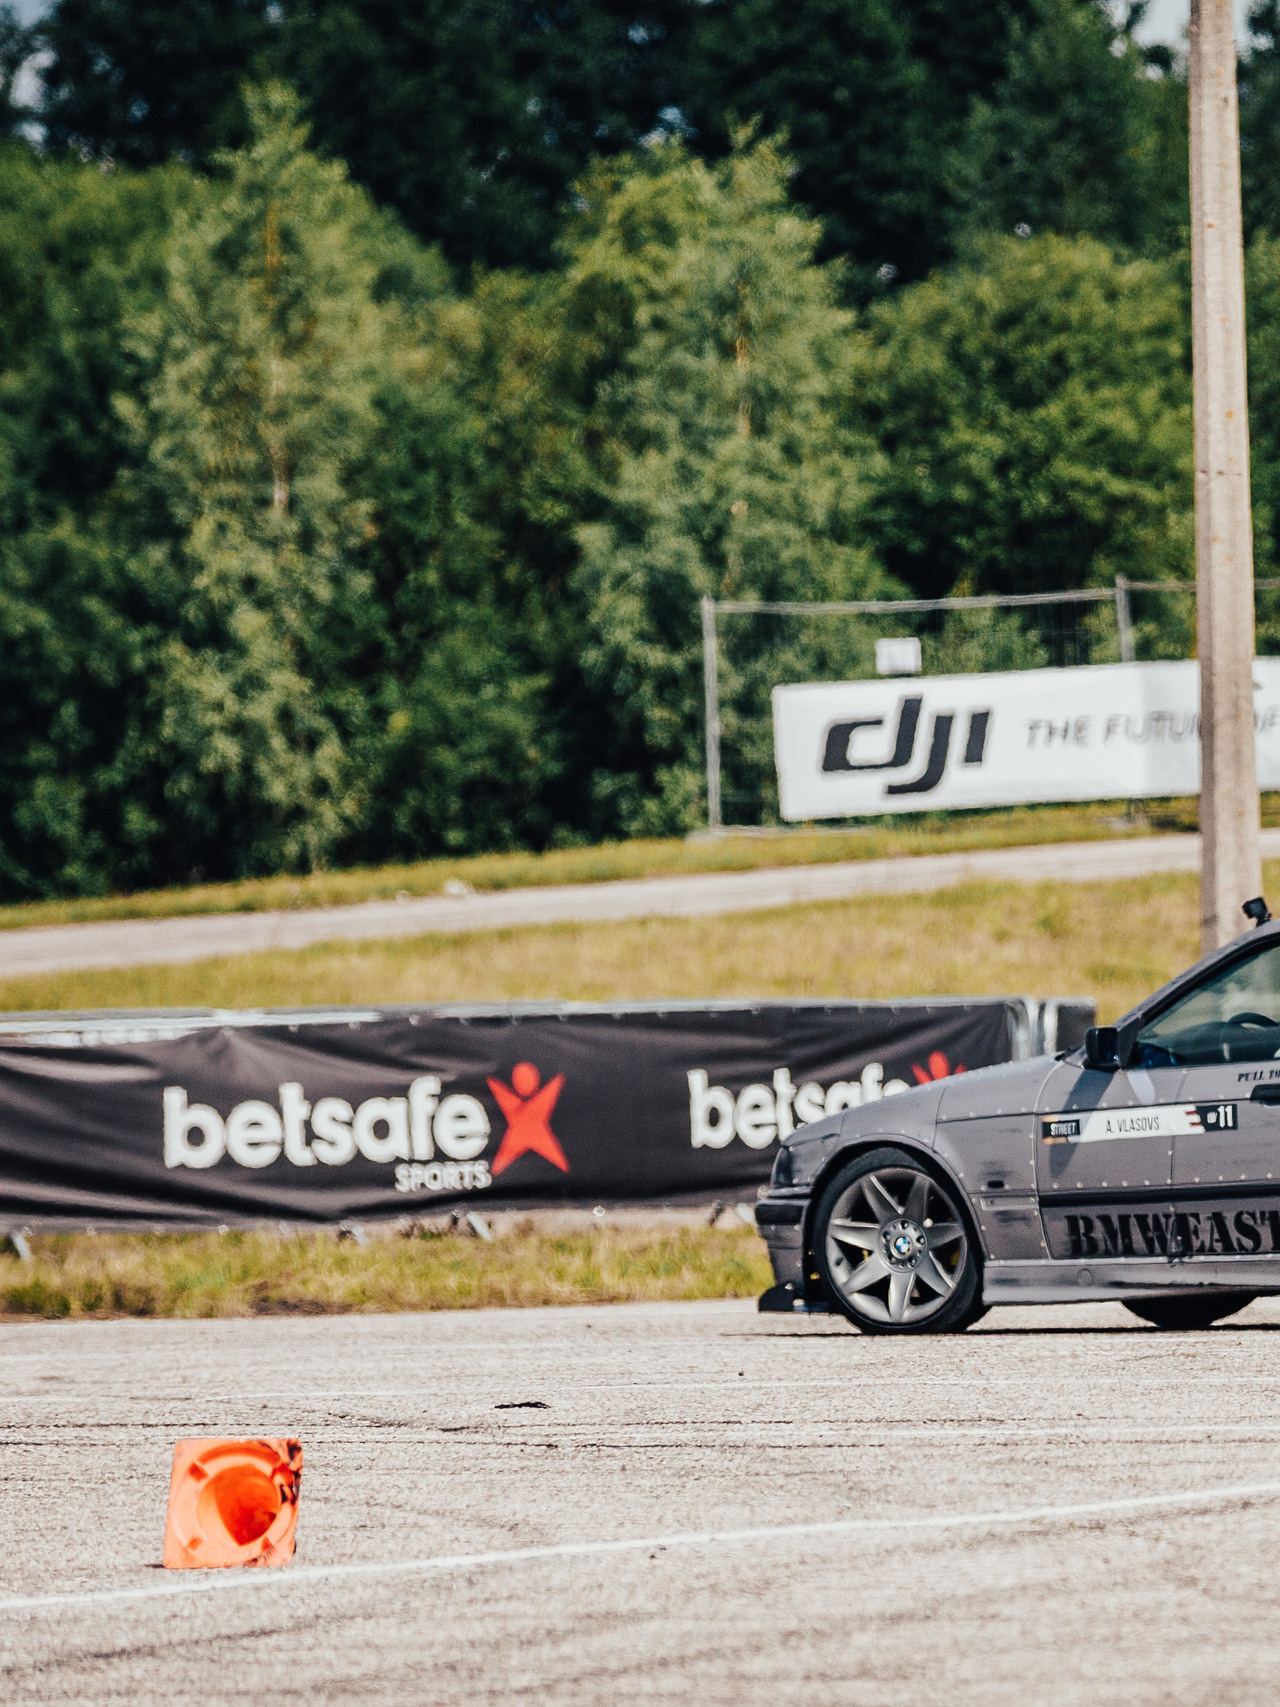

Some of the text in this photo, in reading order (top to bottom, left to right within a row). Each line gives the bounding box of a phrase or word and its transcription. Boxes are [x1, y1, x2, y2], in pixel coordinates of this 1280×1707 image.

[1025, 716, 1093, 748] THE
[1103, 709, 1200, 744] FUTU
[1237, 1070, 1264, 1082] PULL
[687, 1062, 911, 1150] betsaf
[1217, 1105, 1234, 1128] 11
[163, 1076, 490, 1169] betsafe
[1050, 1121, 1077, 1136] STREET
[1105, 1116, 1160, 1133] A. VLASOVS
[395, 1161, 492, 1192] SPORTS
